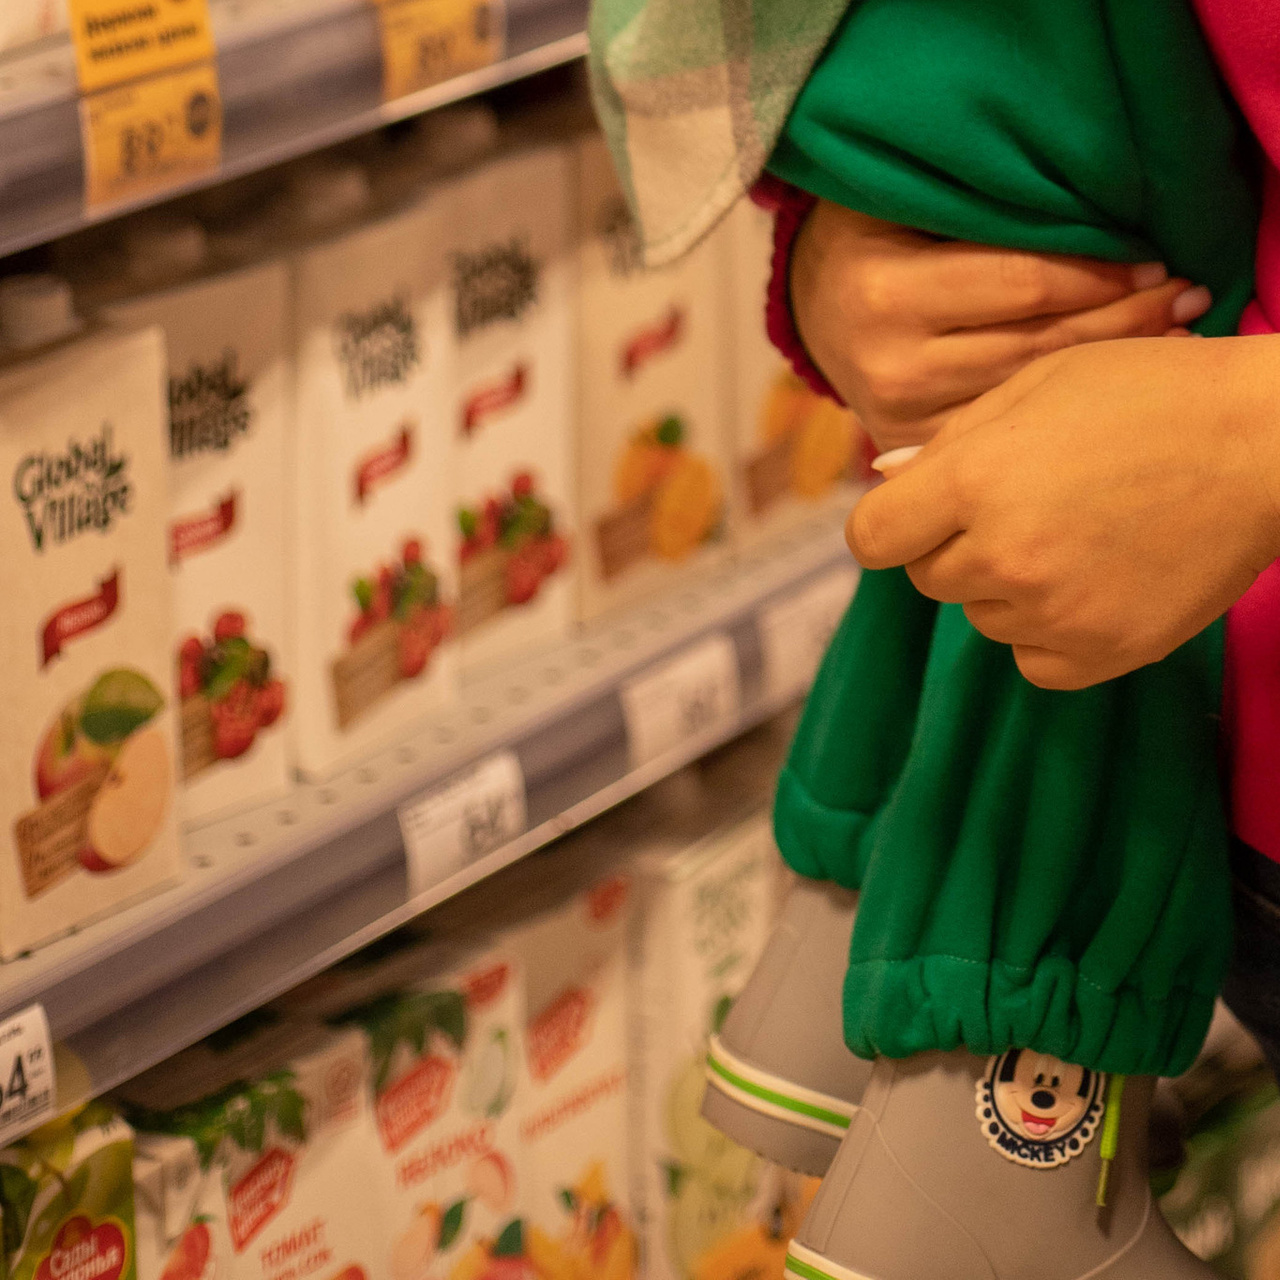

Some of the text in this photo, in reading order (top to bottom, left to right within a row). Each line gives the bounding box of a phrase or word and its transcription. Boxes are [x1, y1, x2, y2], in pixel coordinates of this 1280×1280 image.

[13, 423, 128, 506] Global
[24, 474, 132, 553] Village
[0, 1052, 29, 1114] 4
[996, 1130, 1067, 1163] MICKEY
